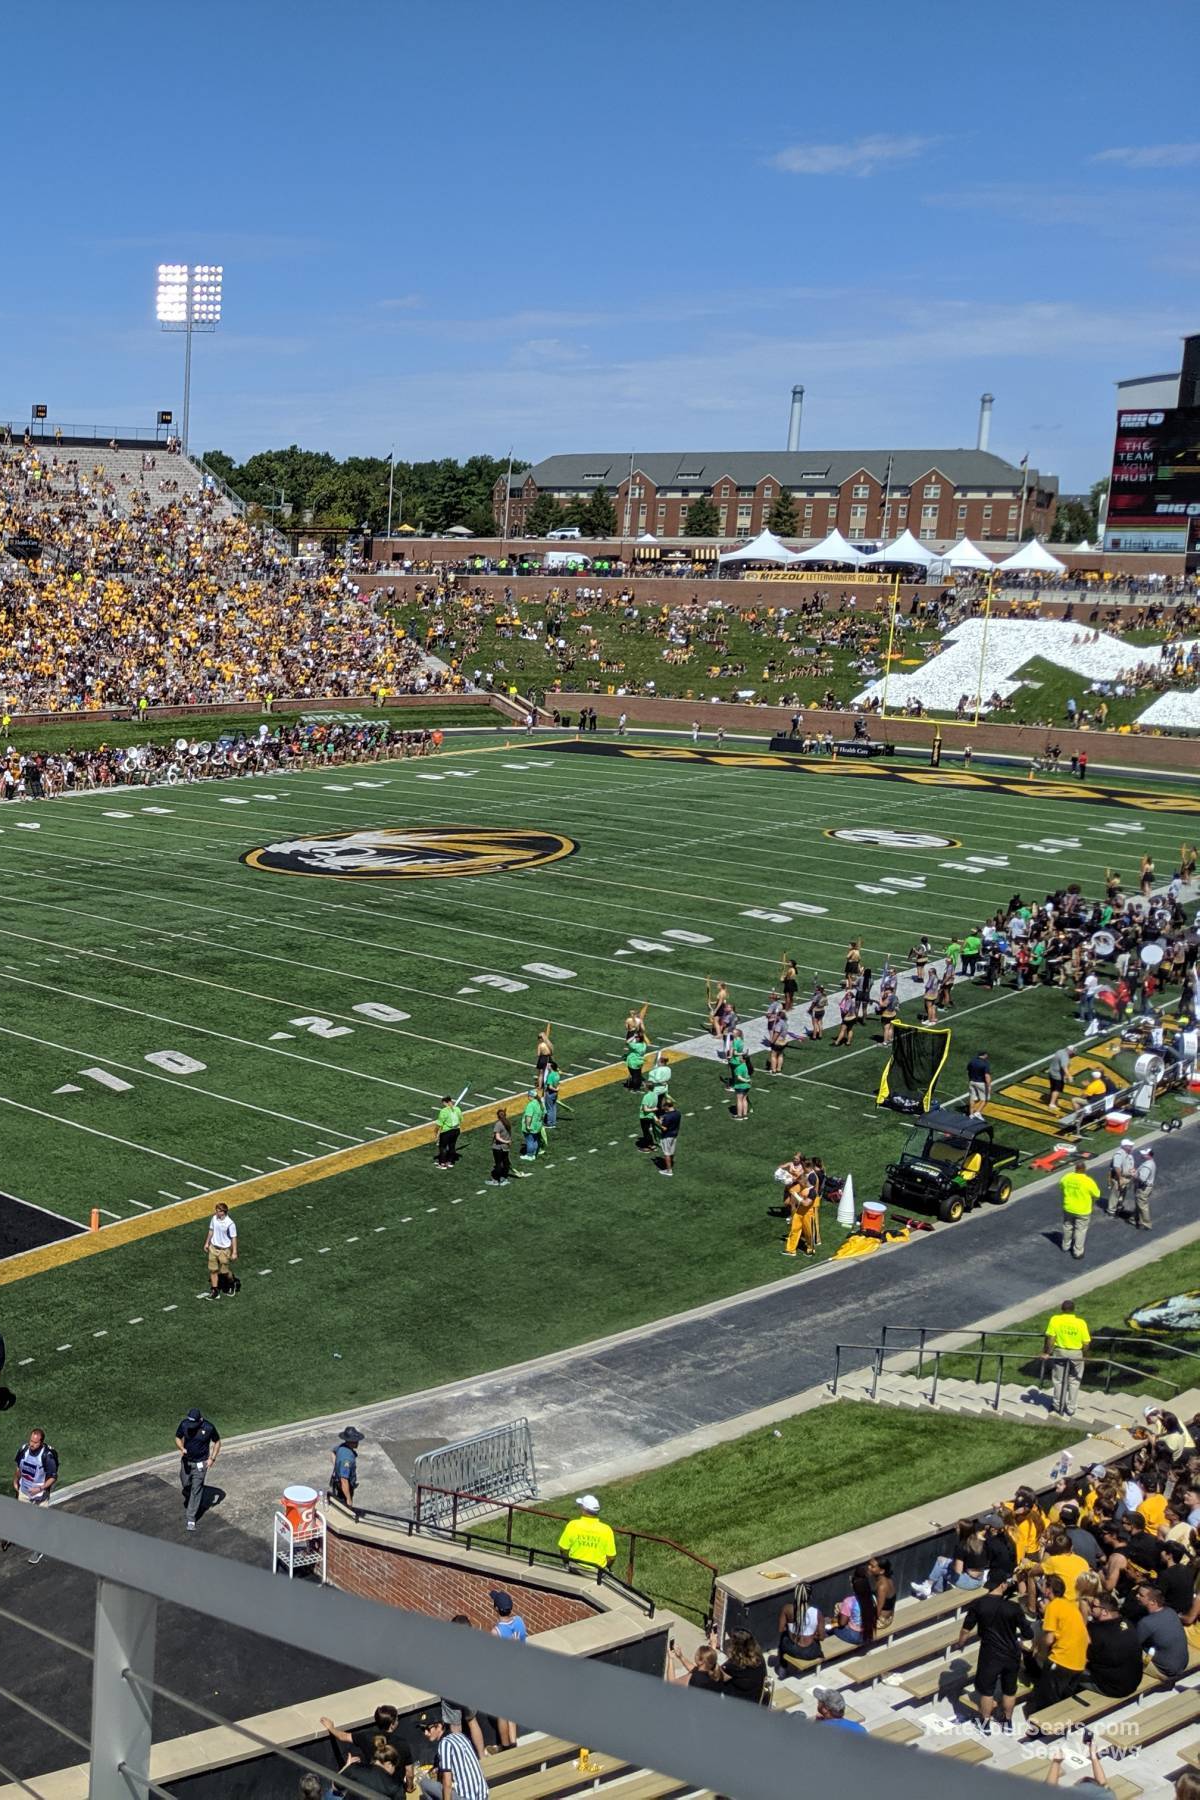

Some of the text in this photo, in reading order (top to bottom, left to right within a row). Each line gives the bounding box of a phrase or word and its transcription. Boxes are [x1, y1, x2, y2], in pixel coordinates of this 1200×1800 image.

[1124, 442, 1150, 450] THE
[1119, 452, 1153, 461] TEAM
[1156, 504, 1186, 513] BIG
[1124, 539, 1153, 548] Health
[877, 575, 888, 583] M
[738, 901, 830, 924] 50
[627, 929, 715, 953] 40
[468, 962, 578, 994] 30
[288, 1002, 412, 1039] 20
[78, 1050, 208, 1092] 10
